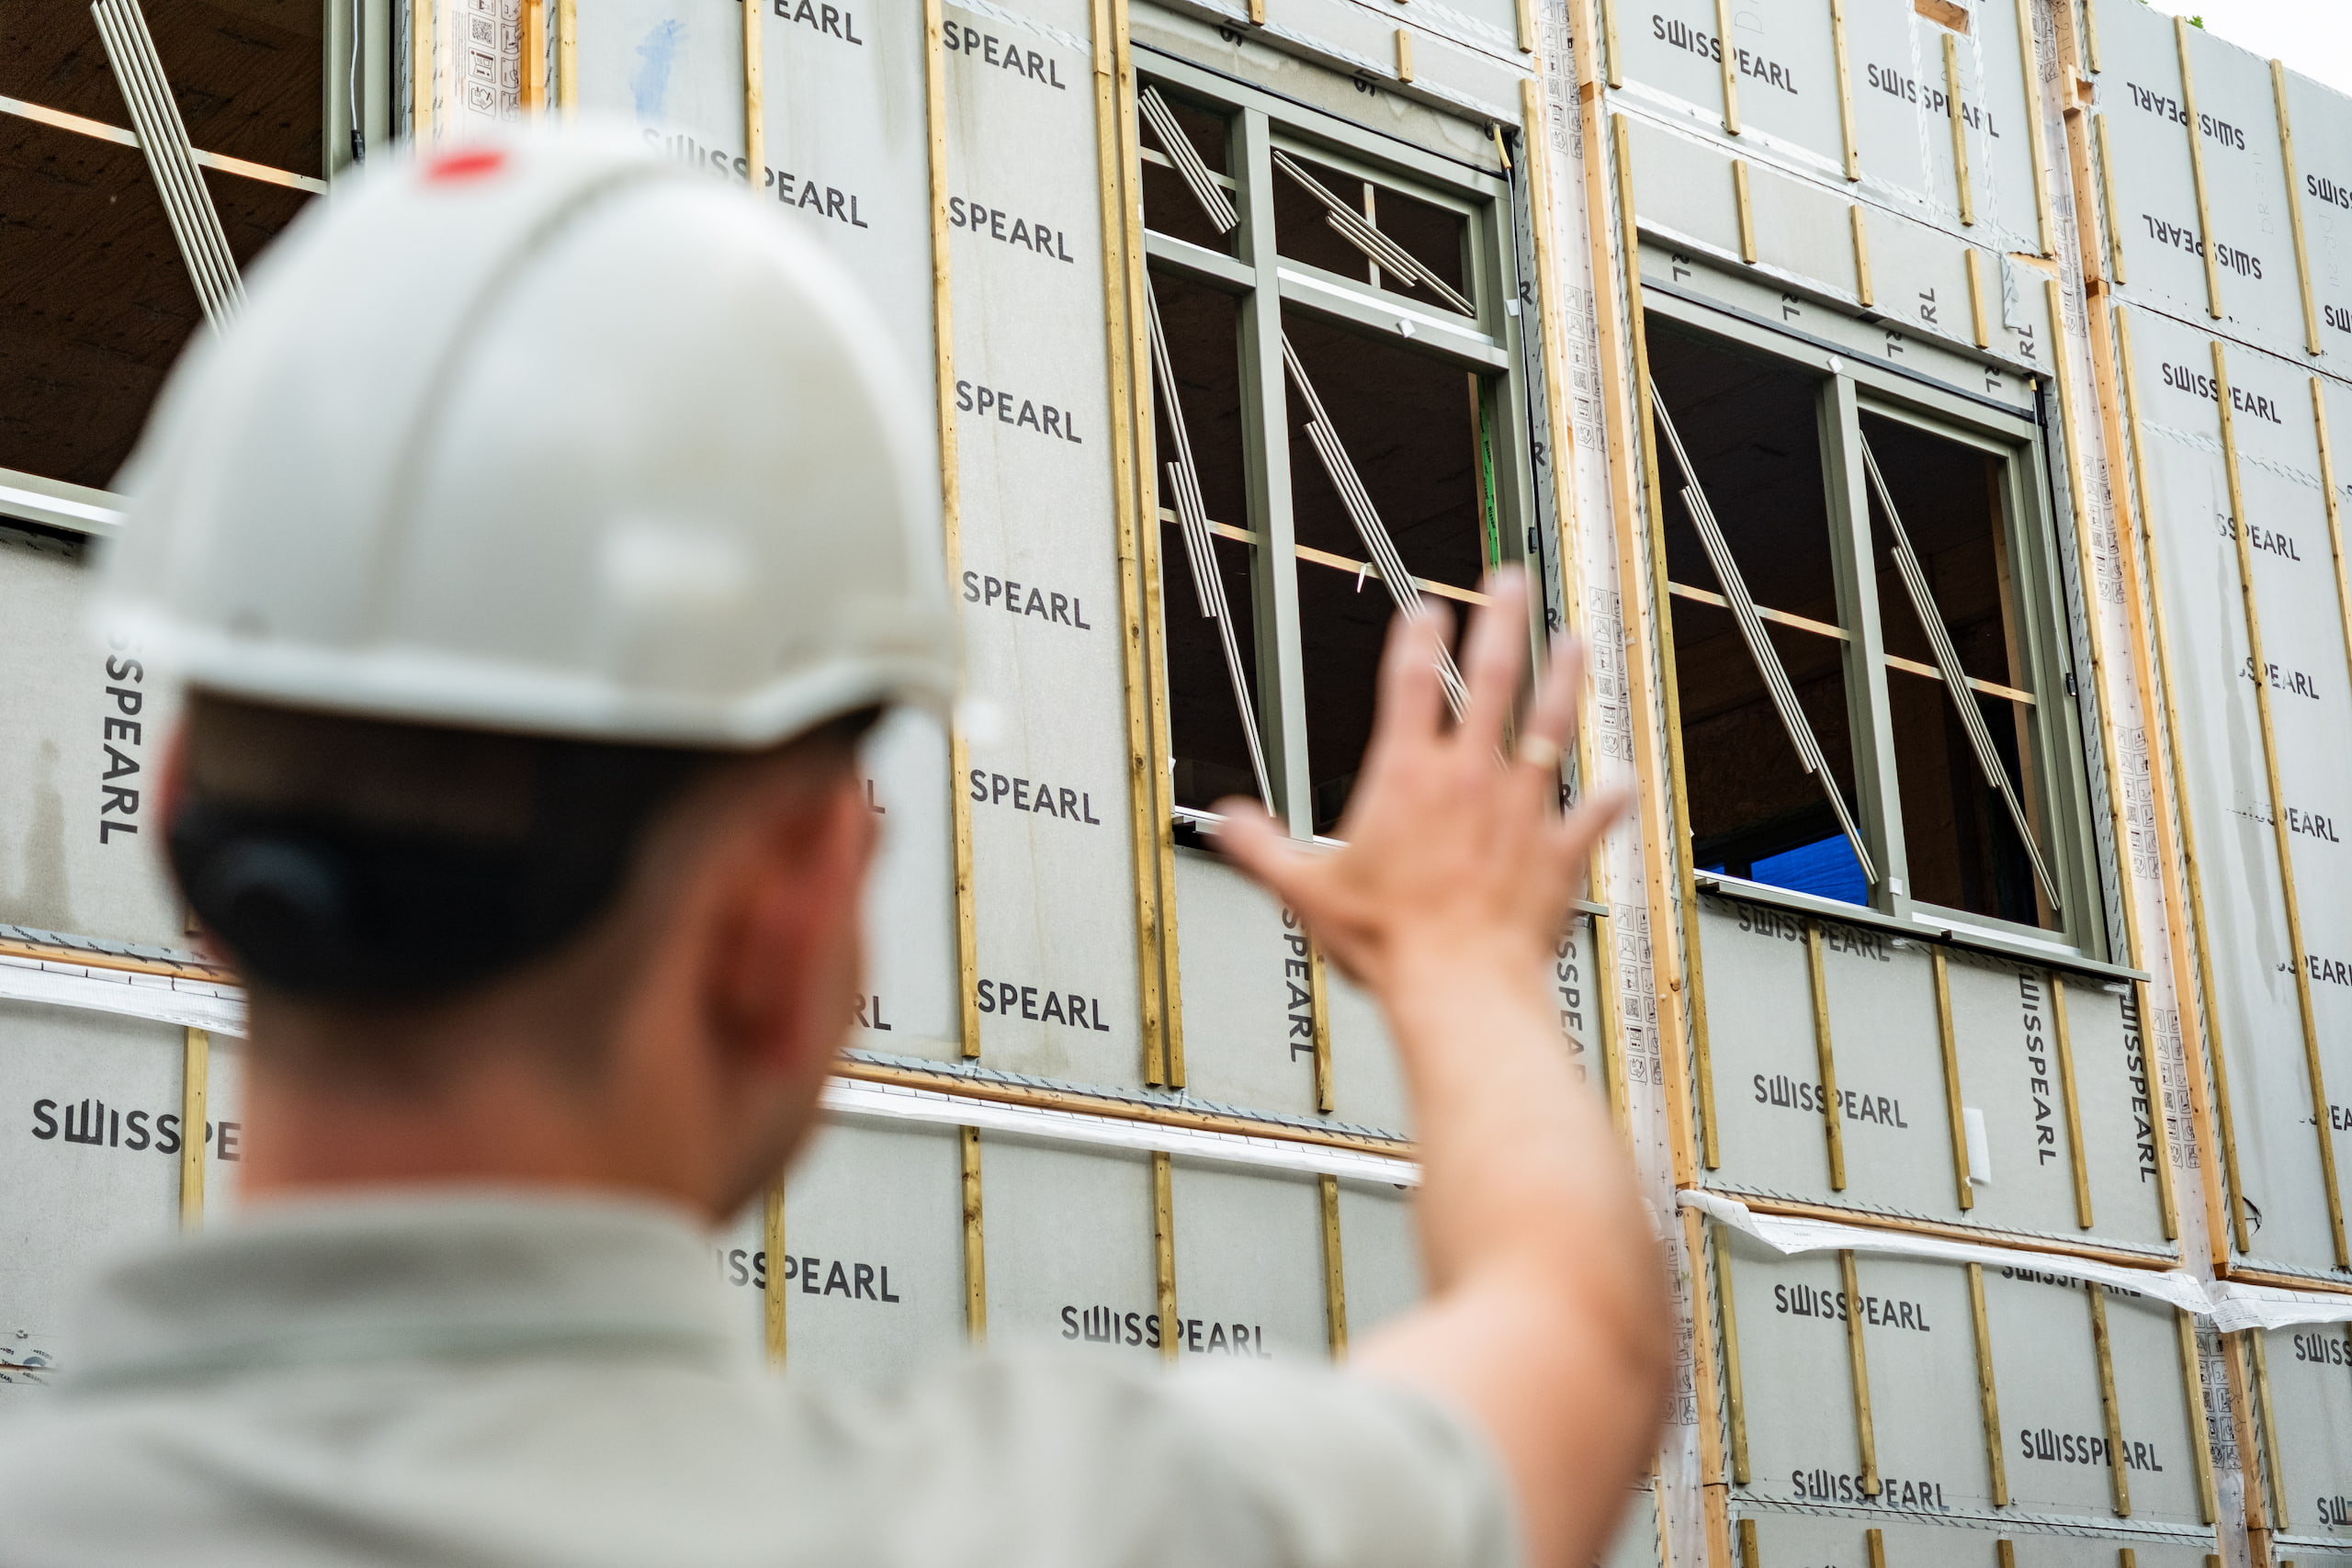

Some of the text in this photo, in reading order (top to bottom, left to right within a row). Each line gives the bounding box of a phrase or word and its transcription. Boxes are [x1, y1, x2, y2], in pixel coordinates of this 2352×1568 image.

[943, 20, 1066, 90] SPEARL
[1653, 15, 1798, 95] SWISSEARL
[2127, 82, 2245, 151] SWISPEARL
[2307, 175, 2352, 209] SWIS
[949, 196, 1074, 264] SPEARL
[2143, 214, 2263, 279] SWISPEARL
[956, 380, 1081, 445] SPEARL
[2162, 363, 2281, 423] SWISSEARL
[962, 570, 1091, 631] SPEARL
[970, 769, 1101, 825] SPEARL
[1737, 905, 1891, 963] SWISSEARL
[978, 979, 1110, 1033] SPEARL
